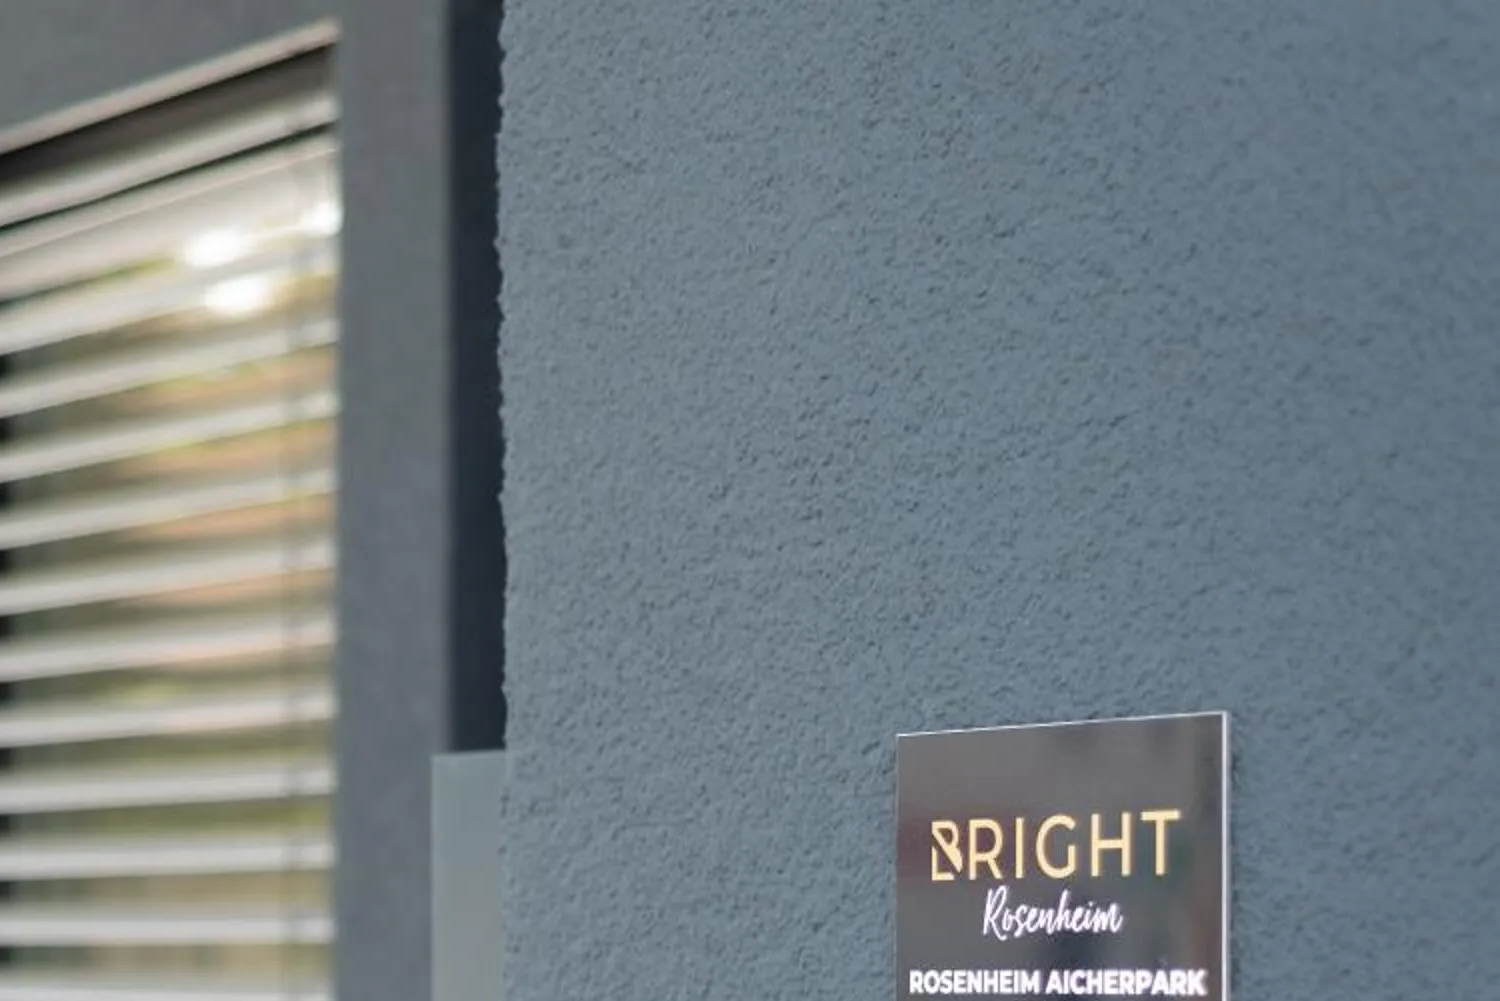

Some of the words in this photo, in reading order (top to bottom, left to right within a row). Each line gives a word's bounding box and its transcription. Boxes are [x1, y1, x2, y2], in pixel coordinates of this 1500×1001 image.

[931, 809, 1181, 881] BRIGHT
[983, 885, 1124, 940] Rosenheim
[909, 970, 1040, 995] ROSENHEIM
[1045, 969, 1208, 996] AICHERPARK
